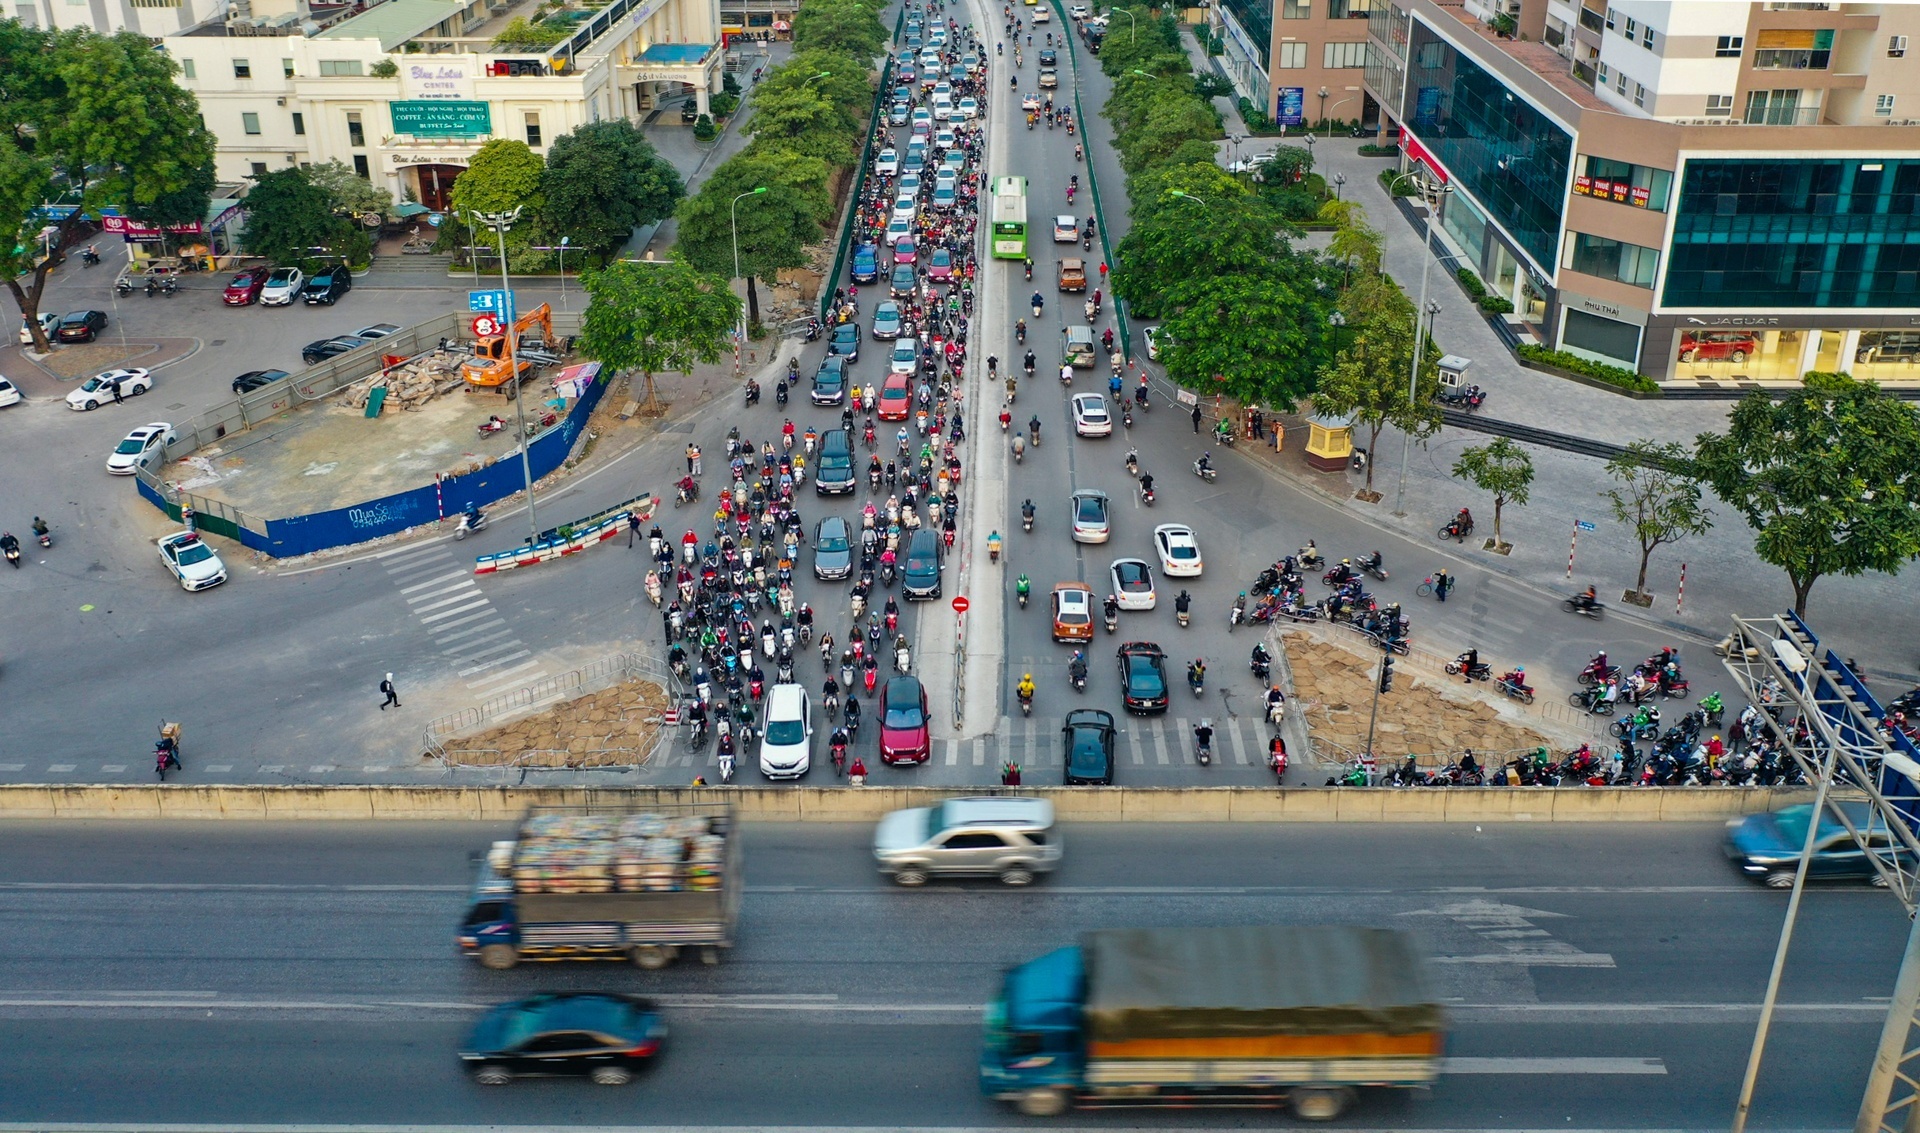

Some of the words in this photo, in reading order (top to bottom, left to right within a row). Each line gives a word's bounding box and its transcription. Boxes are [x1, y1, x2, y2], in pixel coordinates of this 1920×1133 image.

[410, 65, 433, 79] Blue
[435, 66, 463, 79] Lotus
[485, 62, 549, 77] HDBank
[637, 73, 648, 81] 66
[392, 154, 408, 163] Blue
[411, 154, 432, 163] Lotus
[1578, 178, 1590, 186] CHO
[1594, 181, 1609, 190] THUÊ
[1575, 185, 1589, 194] 094
[1593, 189, 1608, 198] 334
[349, 508, 375, 522] Mua
